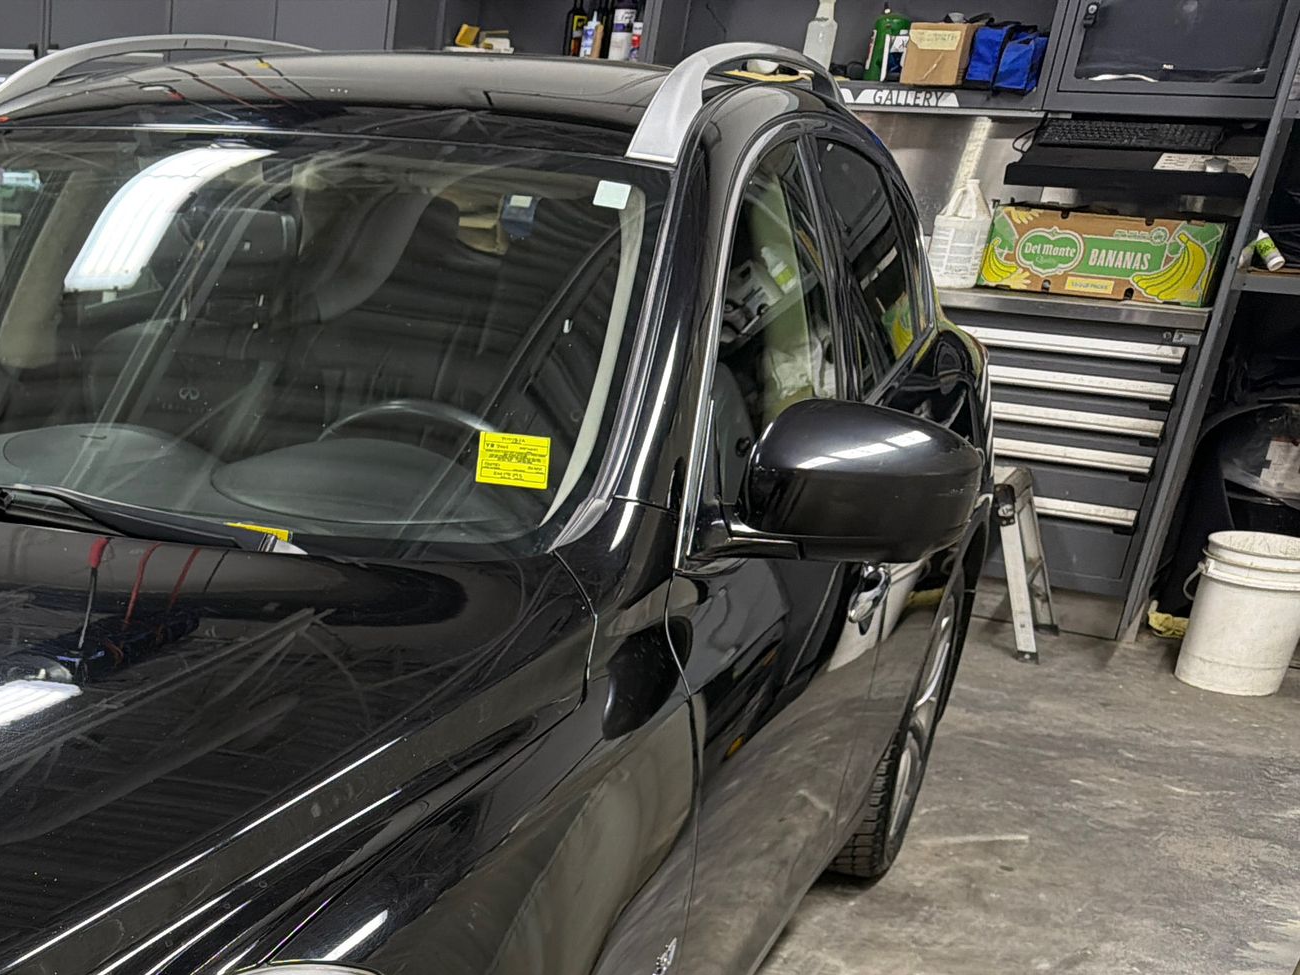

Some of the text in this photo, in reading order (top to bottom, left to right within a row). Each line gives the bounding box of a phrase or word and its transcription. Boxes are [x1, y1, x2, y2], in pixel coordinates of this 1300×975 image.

[874, 89, 944, 107] GALLERY
[1024, 242, 1076, 258] Del Monte
[1088, 249, 1151, 270] BANANAS
